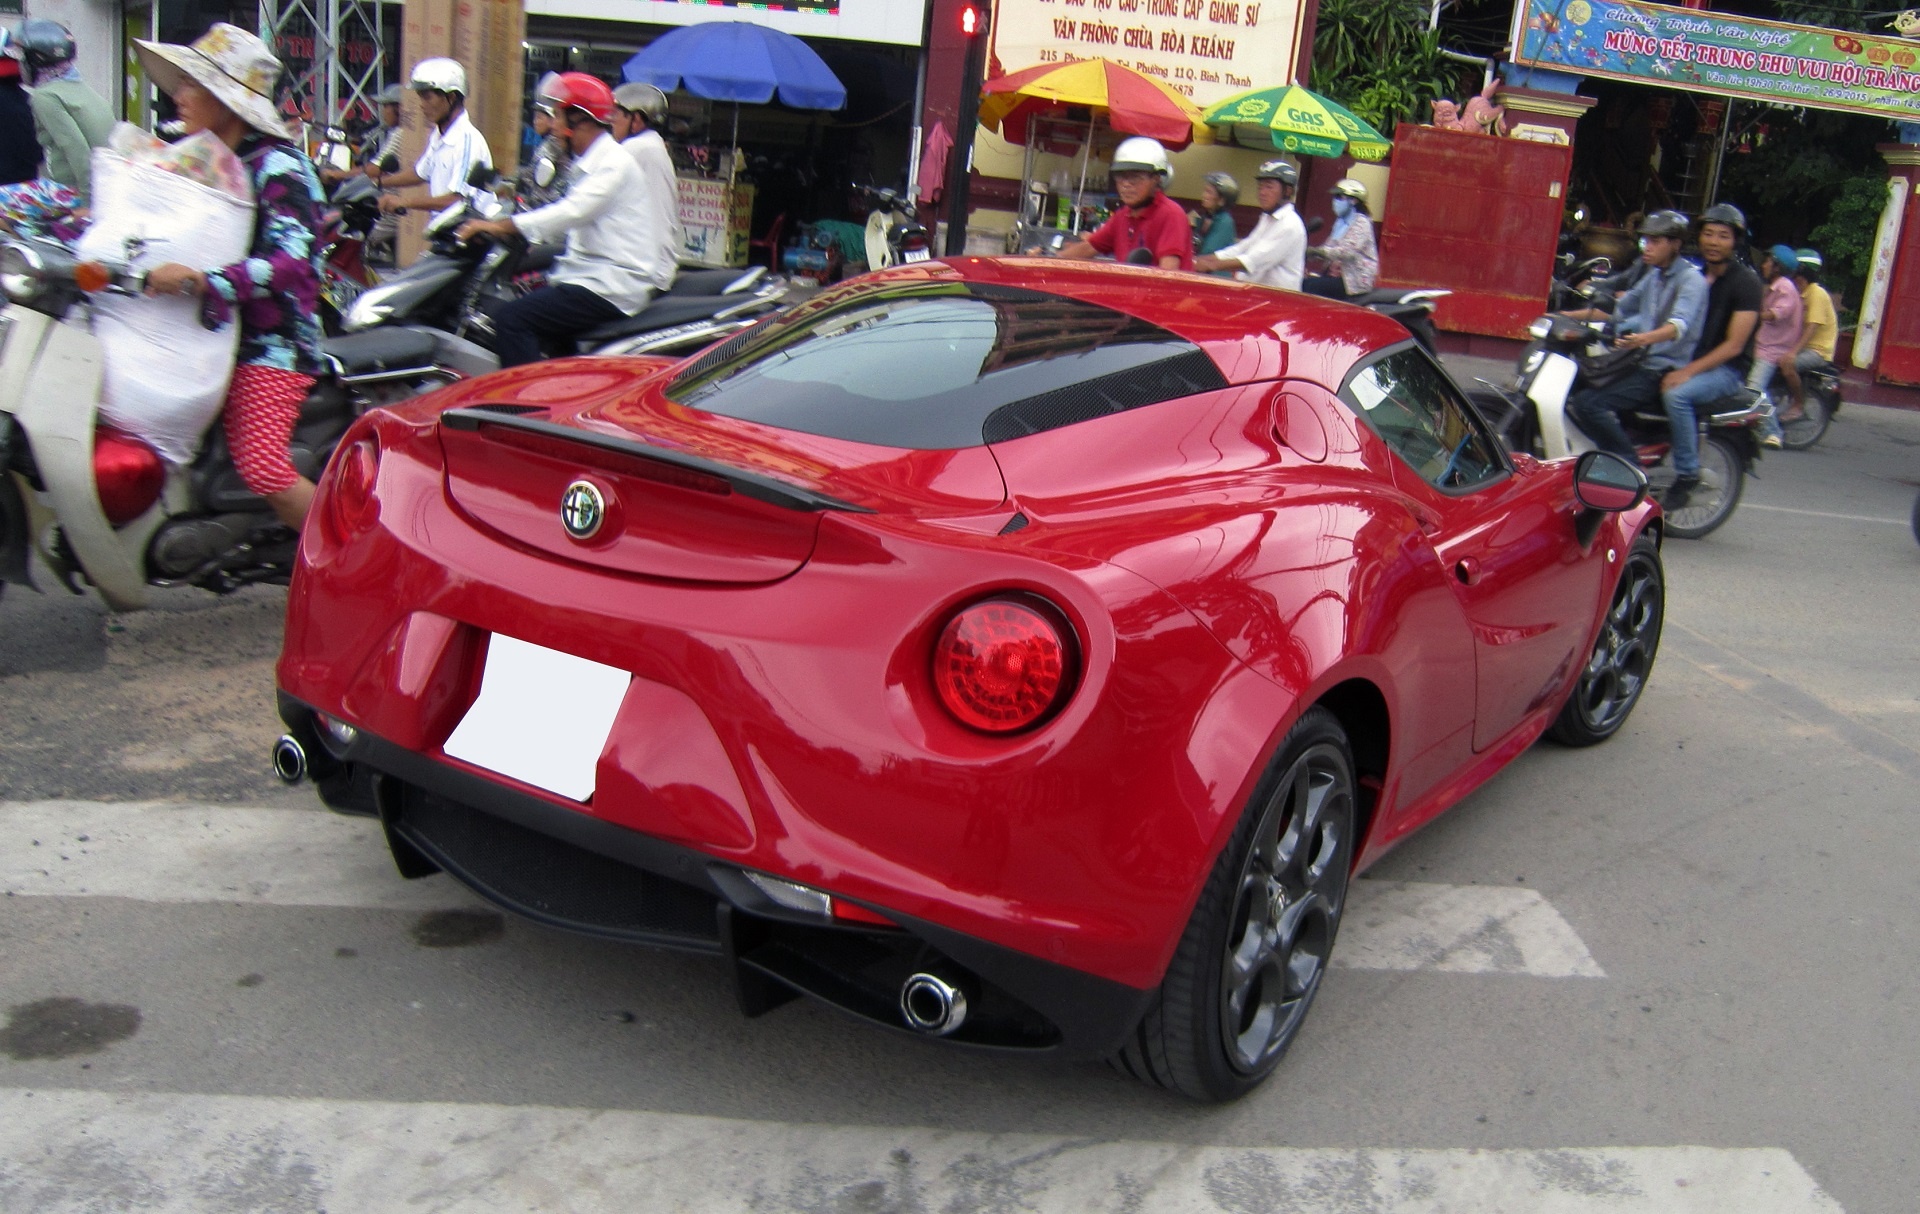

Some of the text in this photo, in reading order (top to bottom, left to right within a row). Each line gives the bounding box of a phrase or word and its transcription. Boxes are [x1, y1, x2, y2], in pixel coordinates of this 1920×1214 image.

[1080, 19, 1118, 45] PHÒNG
[1124, 24, 1153, 50] CHÙA
[1160, 28, 1185, 53] HÒA
[1191, 34, 1235, 61] KHÁNH
[1667, 18, 1713, 34] Trình
[1716, 24, 1749, 40] Văn
[1751, 31, 1790, 47] Nghệ
[1040, 49, 1058, 62] 215
[1136, 61, 1169, 78] Phường
[1200, 69, 1220, 83] Bình
[1225, 73, 1252, 88] Thạnh
[1604, 28, 1920, 94] MỪNG TẾT TRUNG THU VUI HỘI TRĂNG
[1707, 71, 1726, 83] Vào
[1727, 74, 1743, 86] lúc
[1745, 77, 1774, 89] 19h30
[1288, 108, 1325, 127] GAS
